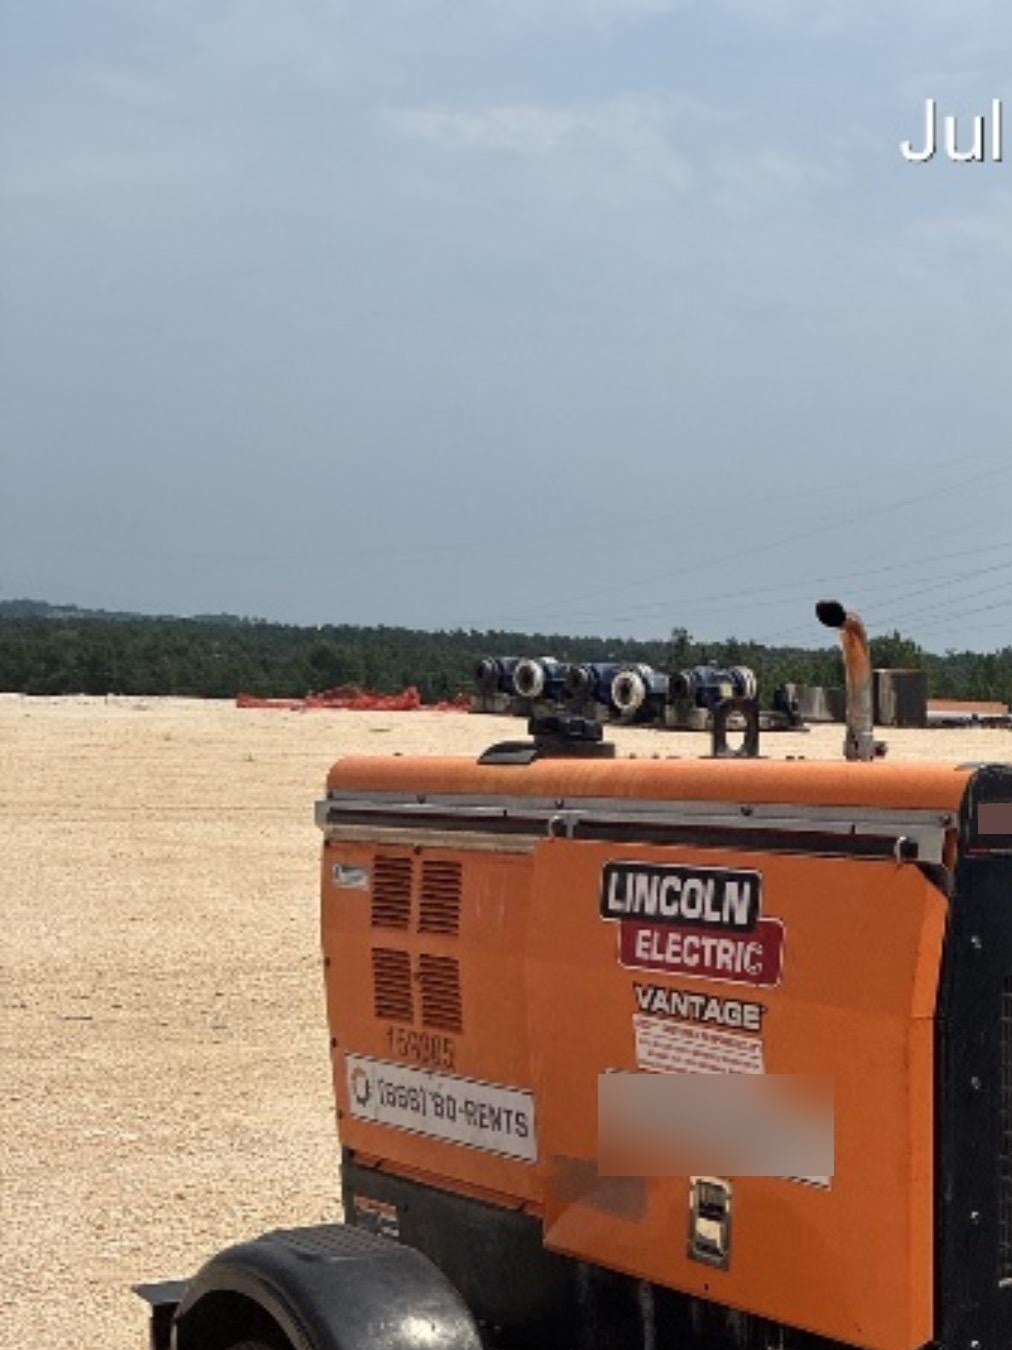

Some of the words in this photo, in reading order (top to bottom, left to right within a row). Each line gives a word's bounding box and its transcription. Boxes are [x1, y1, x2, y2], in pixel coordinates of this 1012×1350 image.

[607, 872, 751, 925] LINCOLN
[634, 929, 763, 976] ELECTRIC
[633, 981, 763, 1032] VANTAGE
